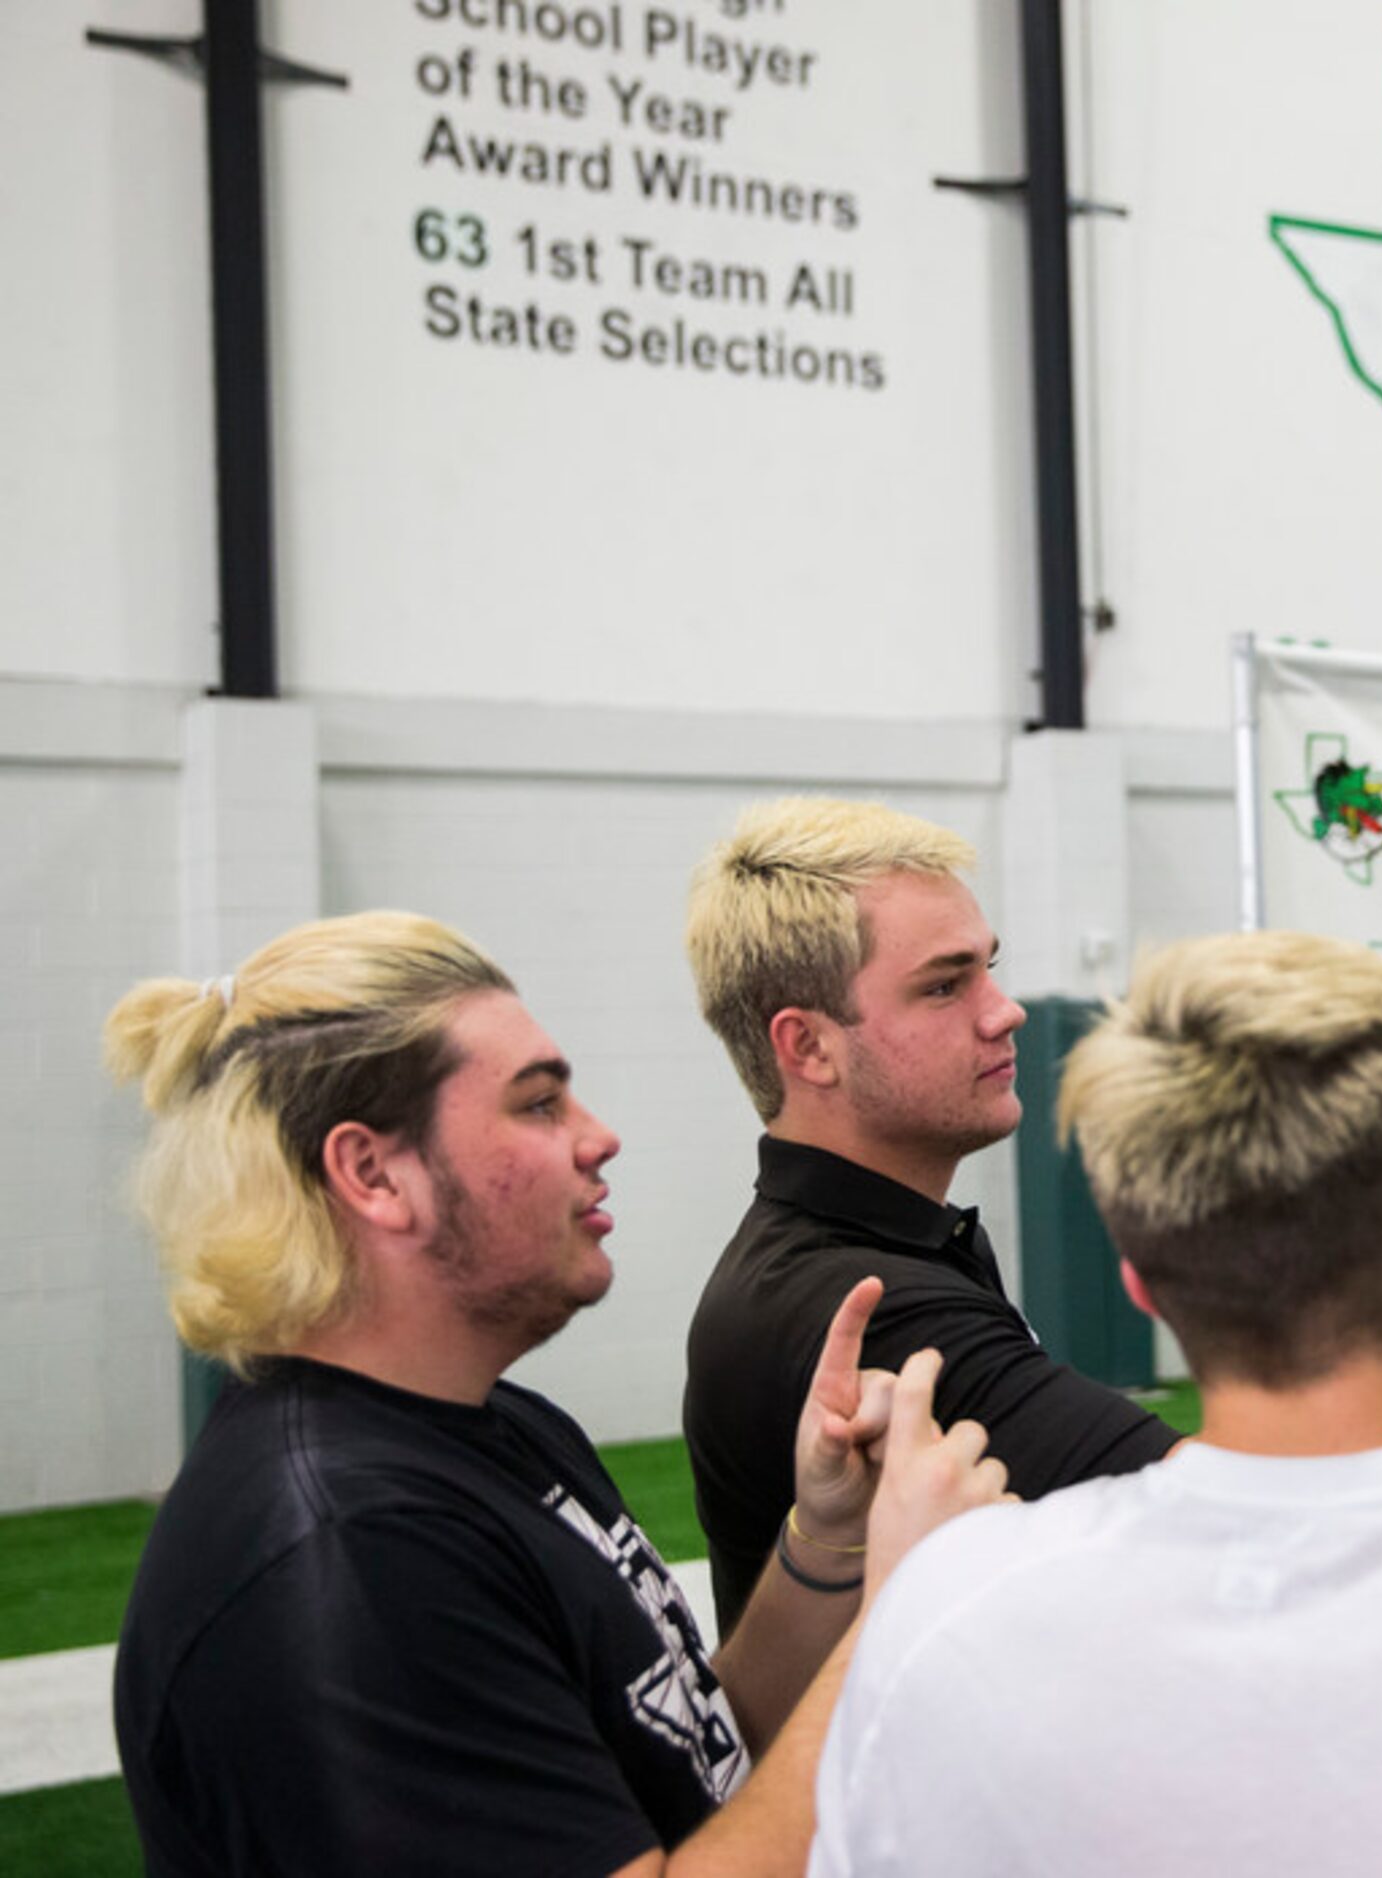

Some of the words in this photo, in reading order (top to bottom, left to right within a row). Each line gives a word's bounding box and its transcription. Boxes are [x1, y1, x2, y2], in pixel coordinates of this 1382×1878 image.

[416, 48, 474, 98] of
[496, 60, 587, 119] the
[608, 73, 731, 141] Year
[647, 10, 819, 90] Player
[421, 115, 613, 193] Award
[635, 148, 860, 231] Winners
[414, 207, 489, 269] 63
[516, 225, 601, 285] 1st
[622, 238, 768, 304] Team
[786, 264, 855, 316] All
[424, 285, 577, 354] State
[600, 309, 886, 391] Selections
